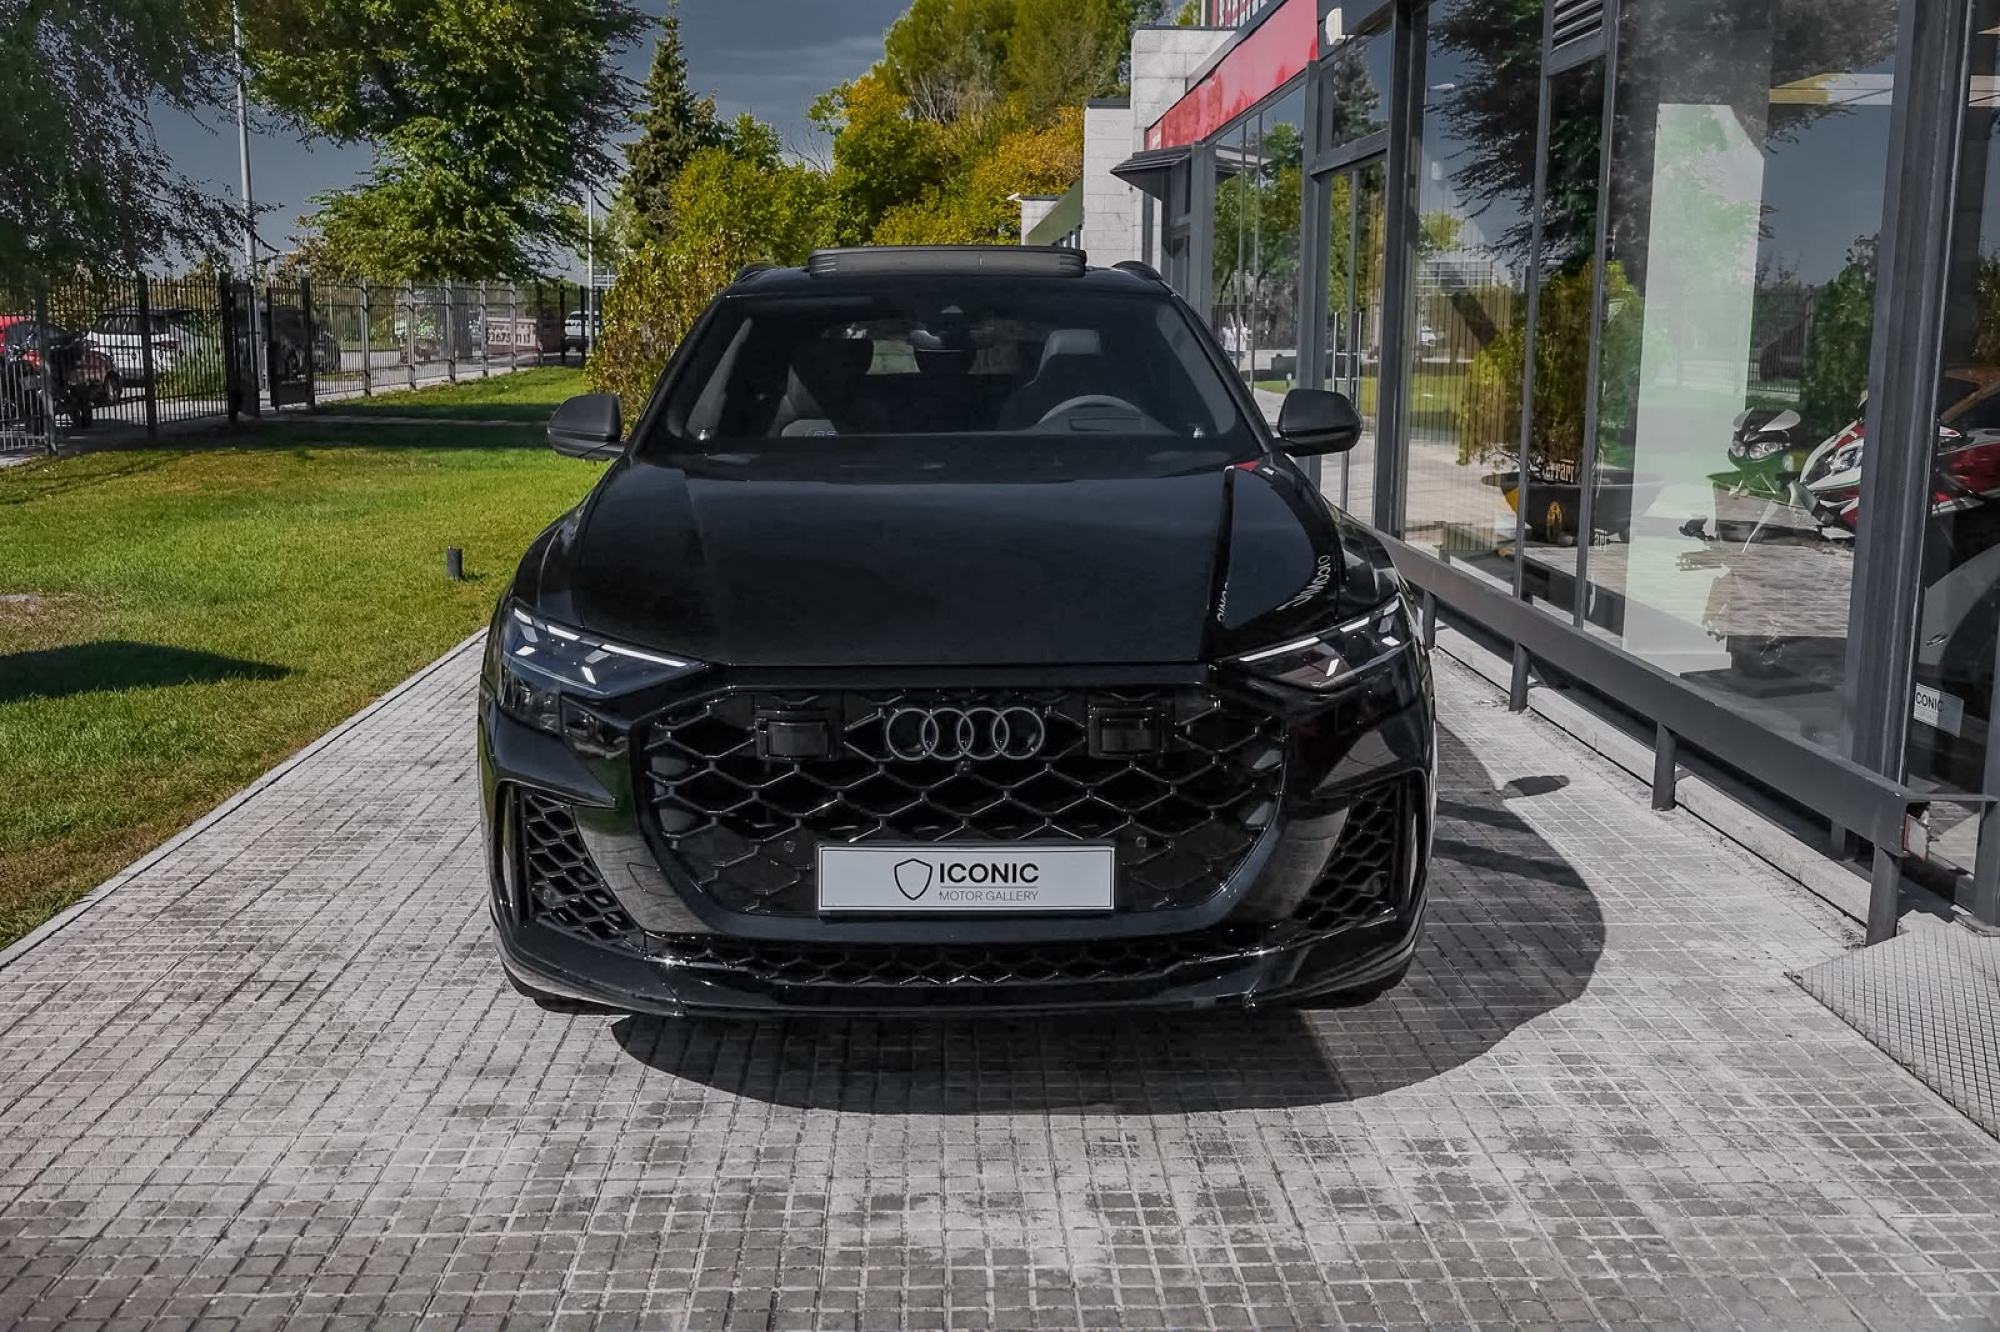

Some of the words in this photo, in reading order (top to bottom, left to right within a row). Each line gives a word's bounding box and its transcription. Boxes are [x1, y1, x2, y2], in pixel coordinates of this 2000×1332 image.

[1915, 691, 1944, 712] CONIC
[939, 862, 1040, 884] ICONIC
[939, 890, 983, 901] MOTOR
[985, 890, 1039, 901] GALLERY
